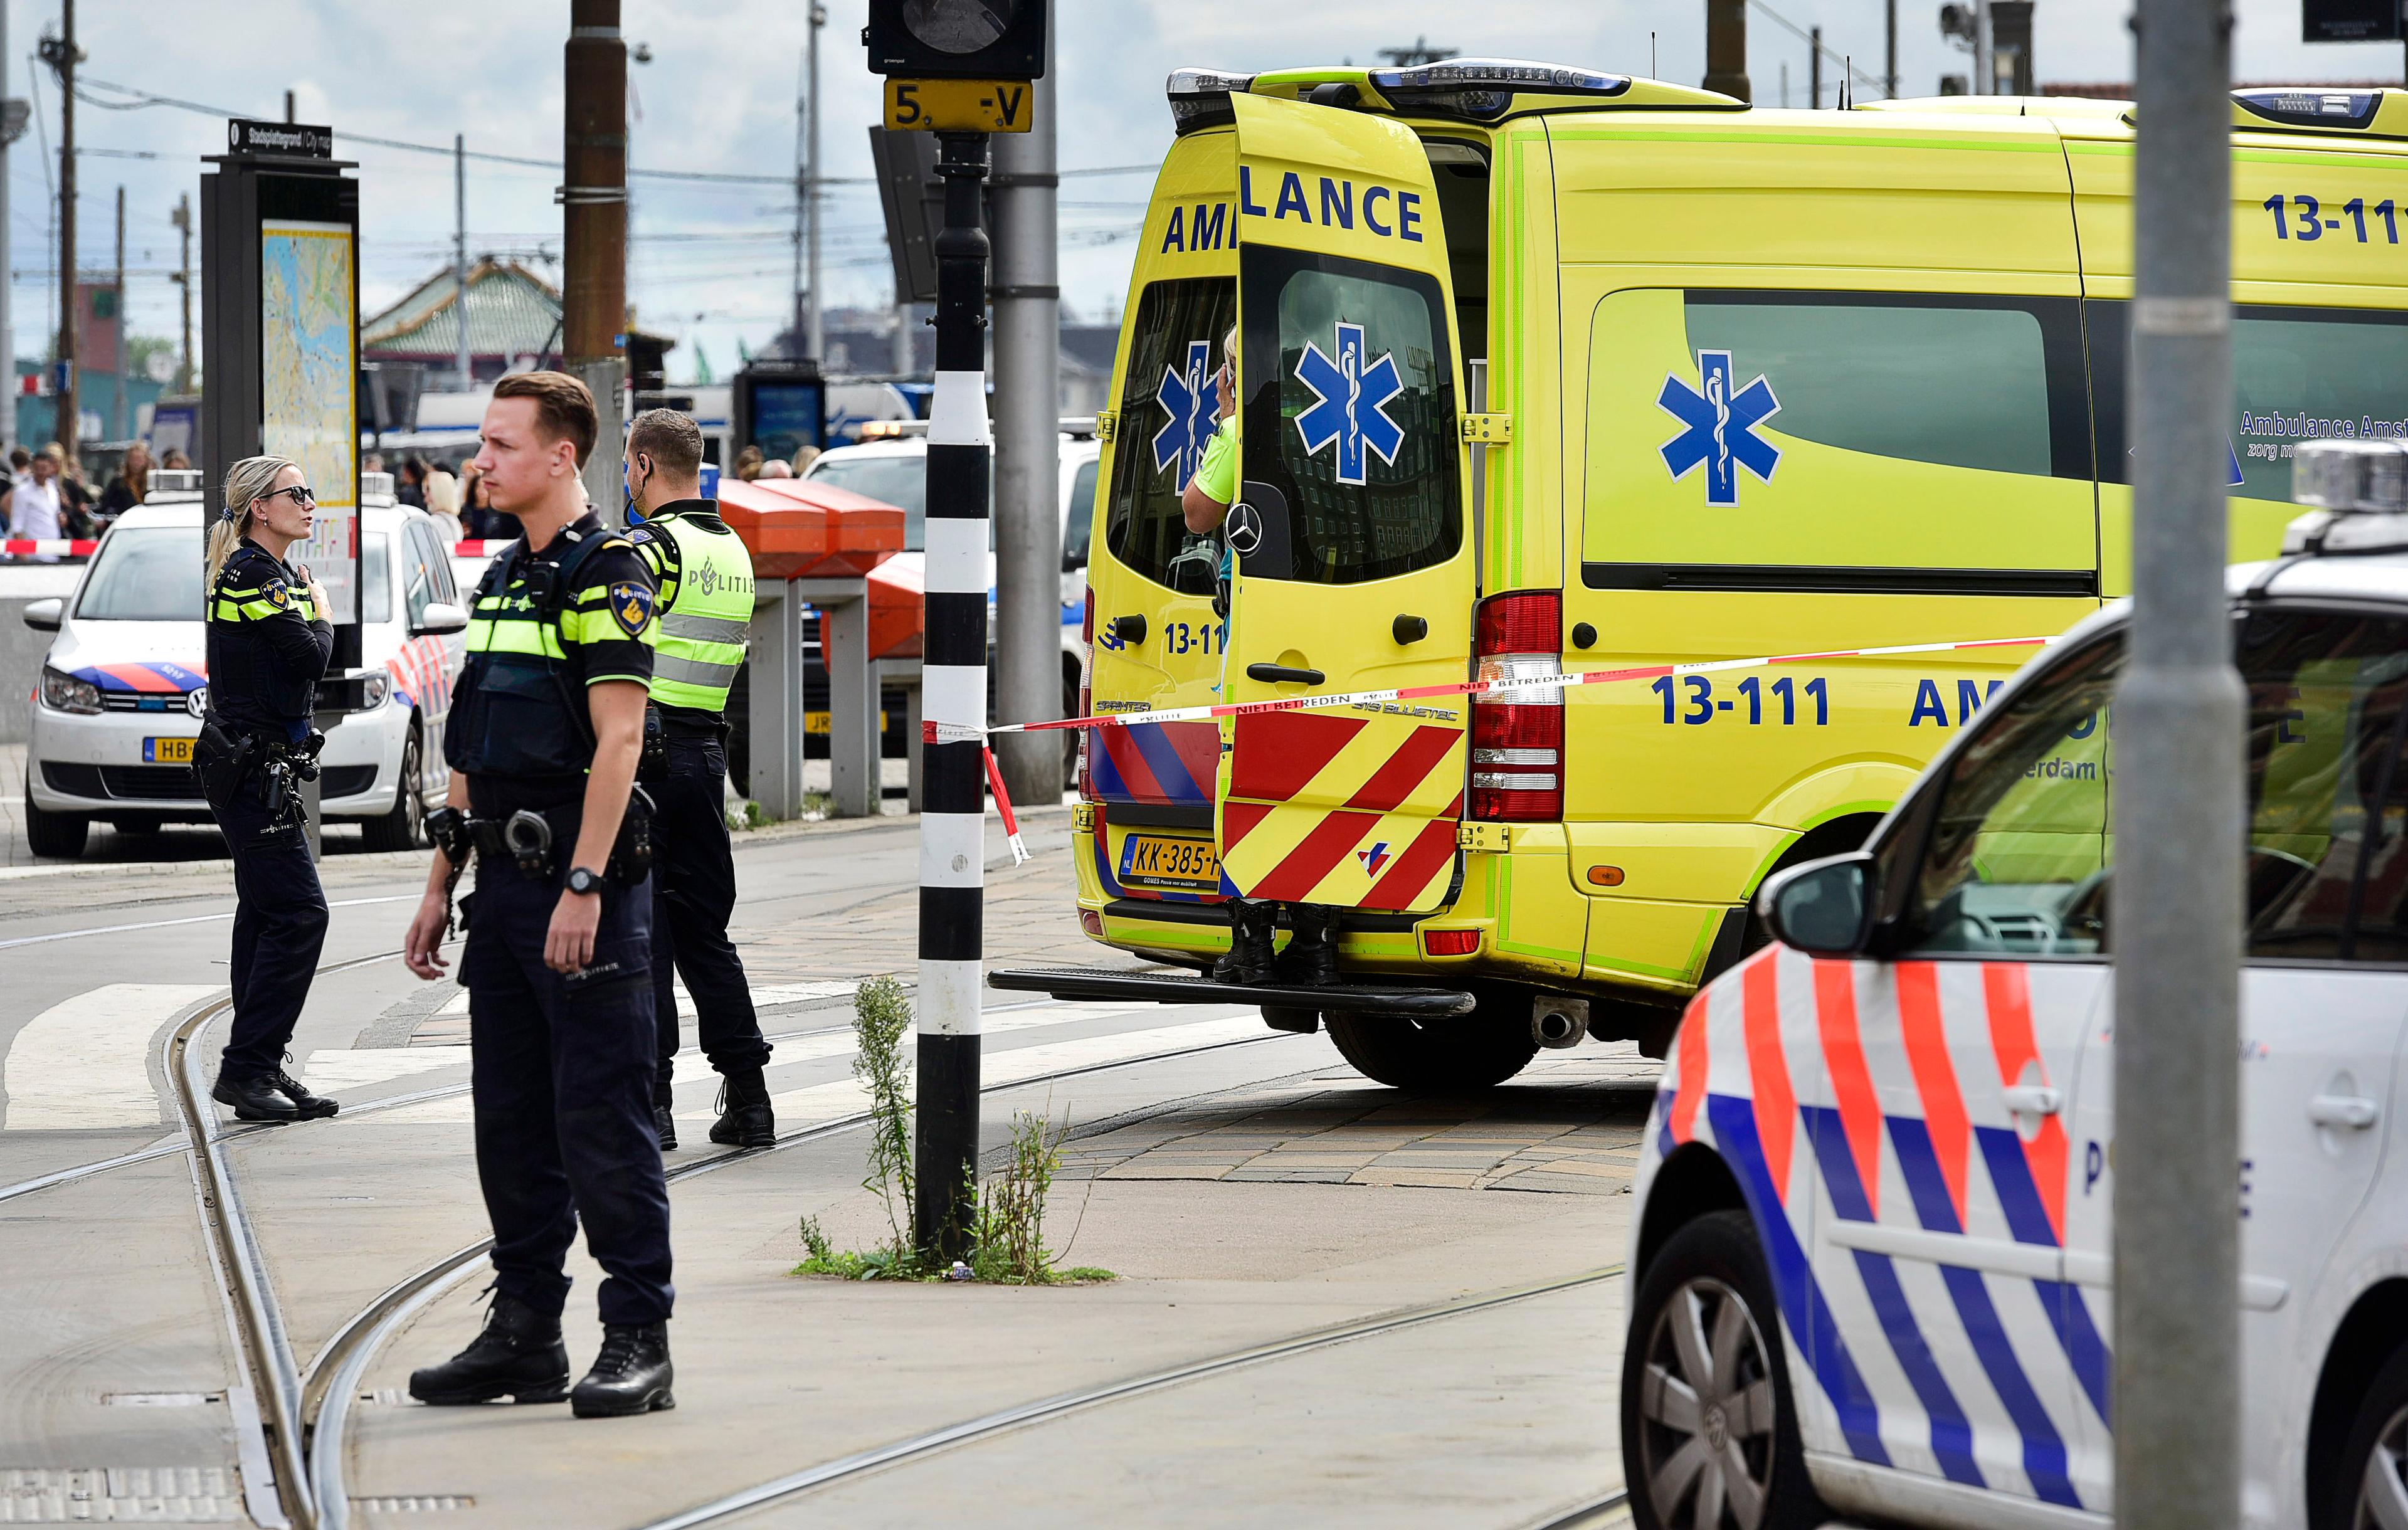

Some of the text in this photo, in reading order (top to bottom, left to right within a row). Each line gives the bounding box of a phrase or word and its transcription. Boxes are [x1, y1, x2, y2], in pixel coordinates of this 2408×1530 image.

[896, 84, 921, 124] 5
[249, 127, 302, 149] Stadsplattegrond
[306, 130, 318, 151] City
[319, 135, 331, 152] map
[1161, 165, 1422, 254] AM LANCE
[2263, 194, 2408, 244] 13-11
[2240, 411, 2355, 438] Ambulance
[2247, 443, 2277, 461] zorg
[689, 557, 754, 596] POLITIE
[614, 586, 650, 601] POLITIE
[1460, 675, 1573, 690] NIET BETREDEN
[1096, 700, 1151, 712] SPRINTER
[1236, 695, 1350, 714] NIET BETREDEN
[1383, 702, 1459, 721] BLUETEC
[1651, 675, 1829, 726] 13-111
[2024, 757, 2096, 781] erdam
[1123, 859, 1131, 868] NL
